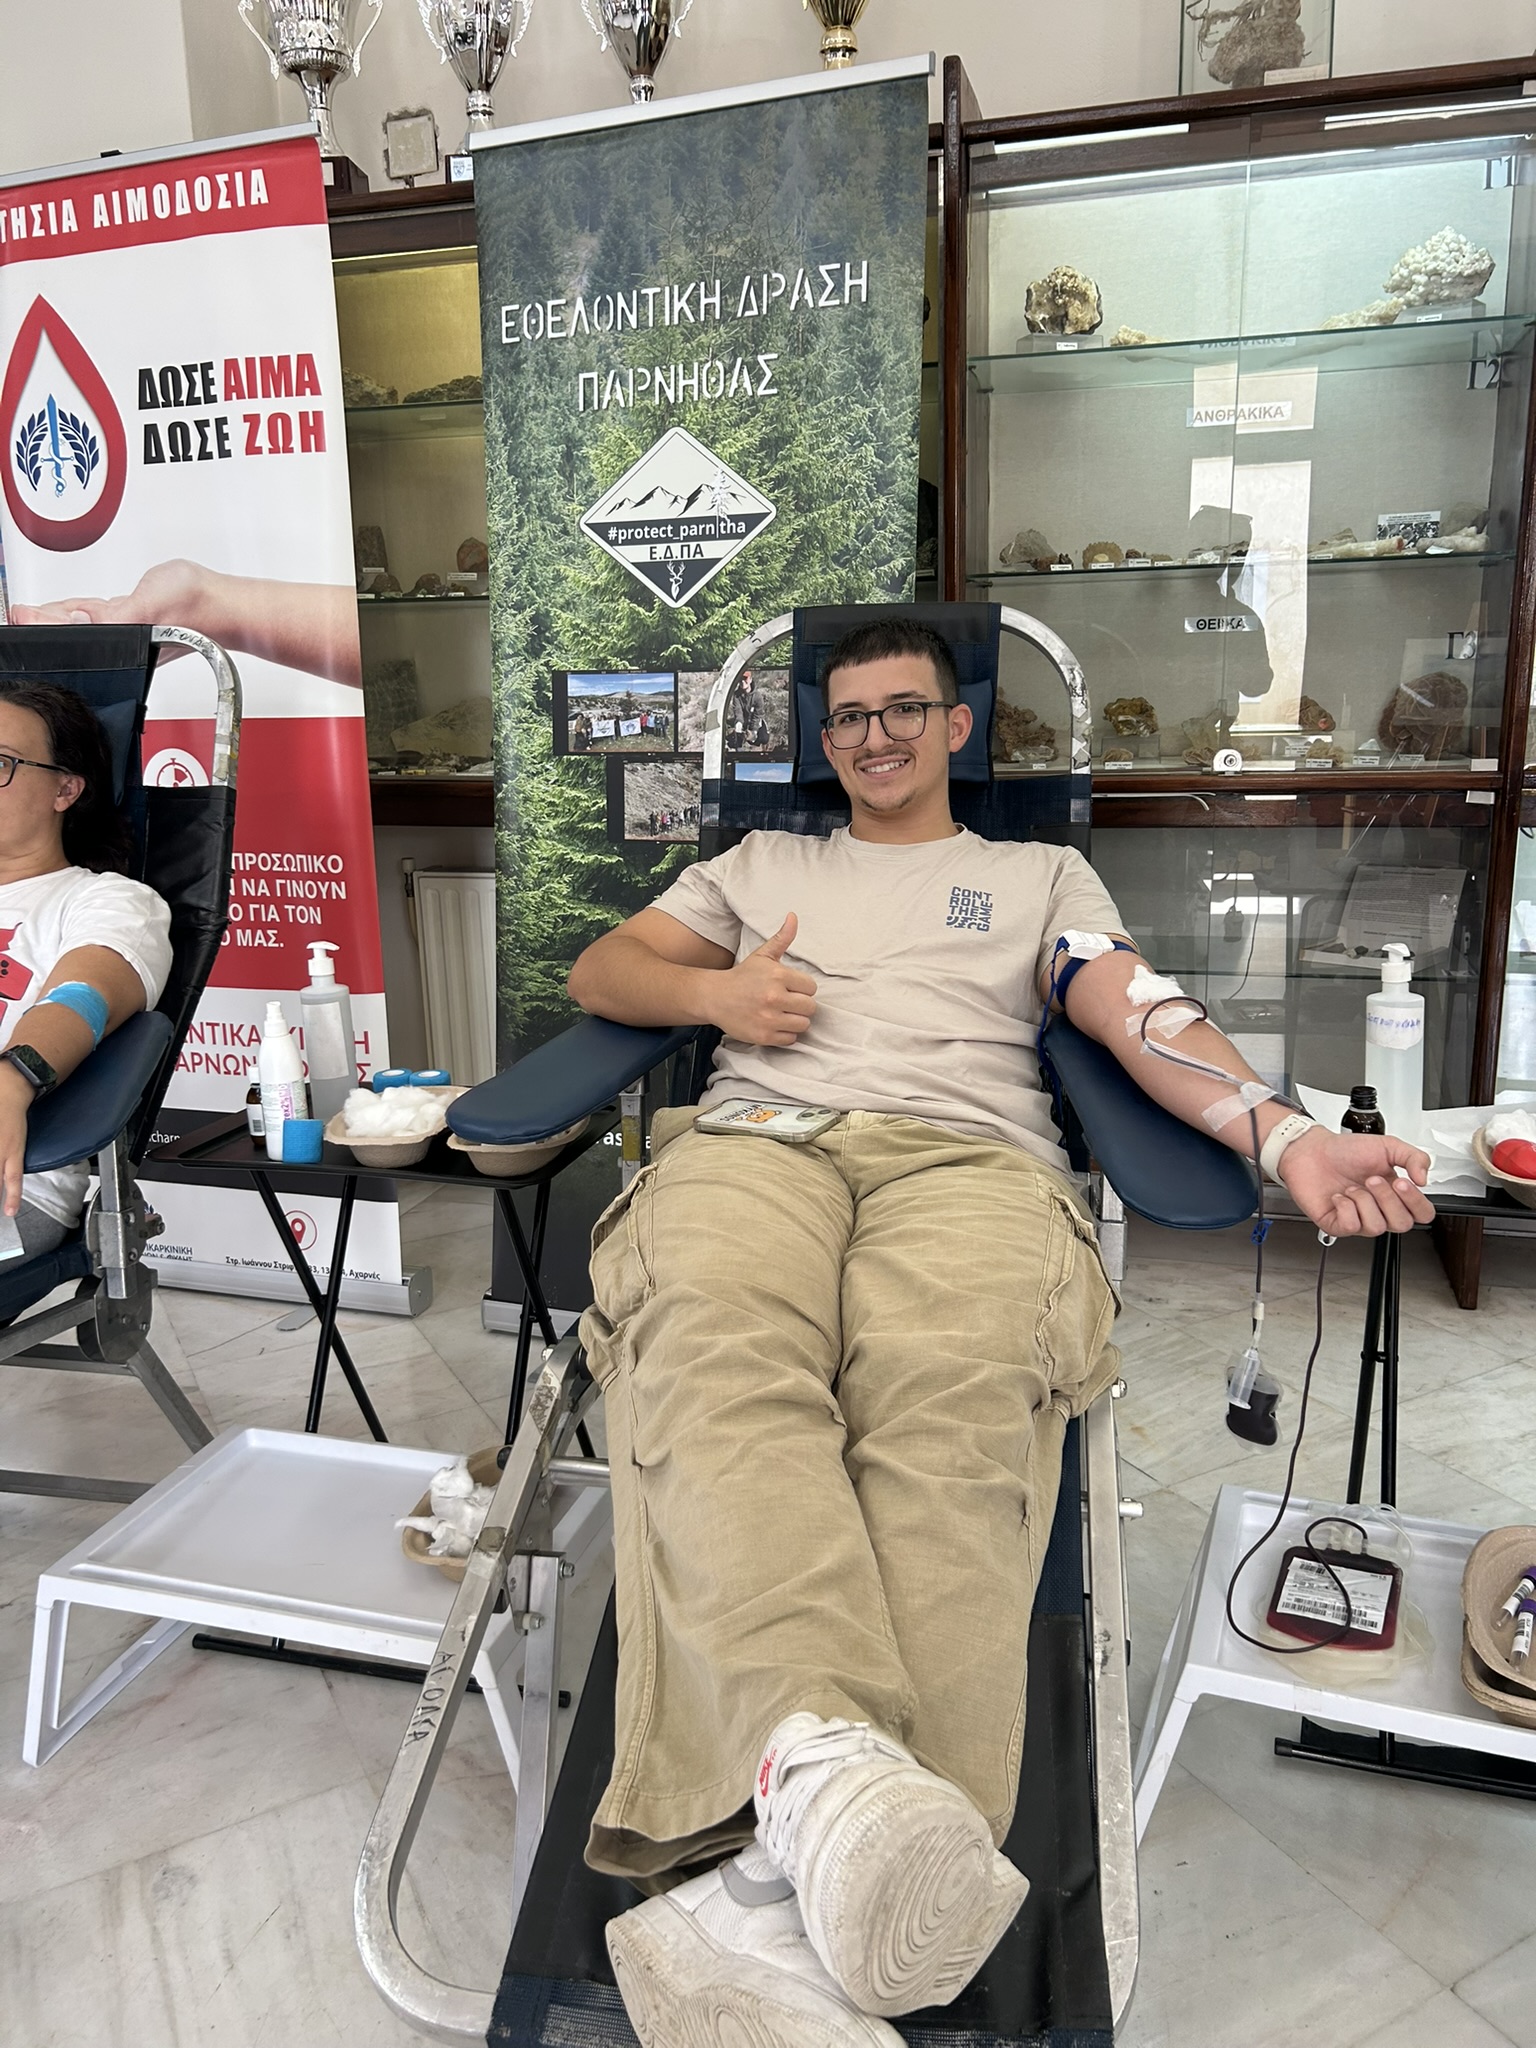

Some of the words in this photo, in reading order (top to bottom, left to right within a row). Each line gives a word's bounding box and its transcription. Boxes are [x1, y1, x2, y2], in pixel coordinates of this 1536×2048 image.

[93, 168, 269, 229] ΑΙΜΟΔΟΣΙΑ
[501, 278, 721, 345] ΕΘΕΛΟΝΤΙΚΗ
[735, 260, 869, 319] ΔΡΑΣΗ
[138, 361, 218, 411] ΔΩΣΕ
[223, 353, 323, 402] ΑΙΜΑ
[577, 352, 779, 413] ΠΑΡΝΗΘΑΣ
[1193, 405, 1285, 423] ΑΝΘΡΑΚΙΚΑ
[143, 416, 232, 465] ΔΩΣΕ
[242, 410, 327, 456] ΖΩΗ
[649, 543, 705, 561] Ε.Δ.ΠΑ
[231, 853, 344, 874] ΠΡΟΣΩΠΙΚΟ
[242, 878, 270, 897] ΝΑ
[275, 879, 347, 900] ΓΙΝΟΥΝ
[249, 904, 281, 923] ΓΙΑ
[284, 905, 322, 925] ΤΟΝ
[949, 905, 979, 917] THE
[236, 929, 284, 948] ΜΑΣ.
[175, 1051, 257, 1077] ΑΡΝΩΝ
[242, 1258, 272, 1268] Ιωάννου
[349, 1269, 381, 1280] Αχαρνές
